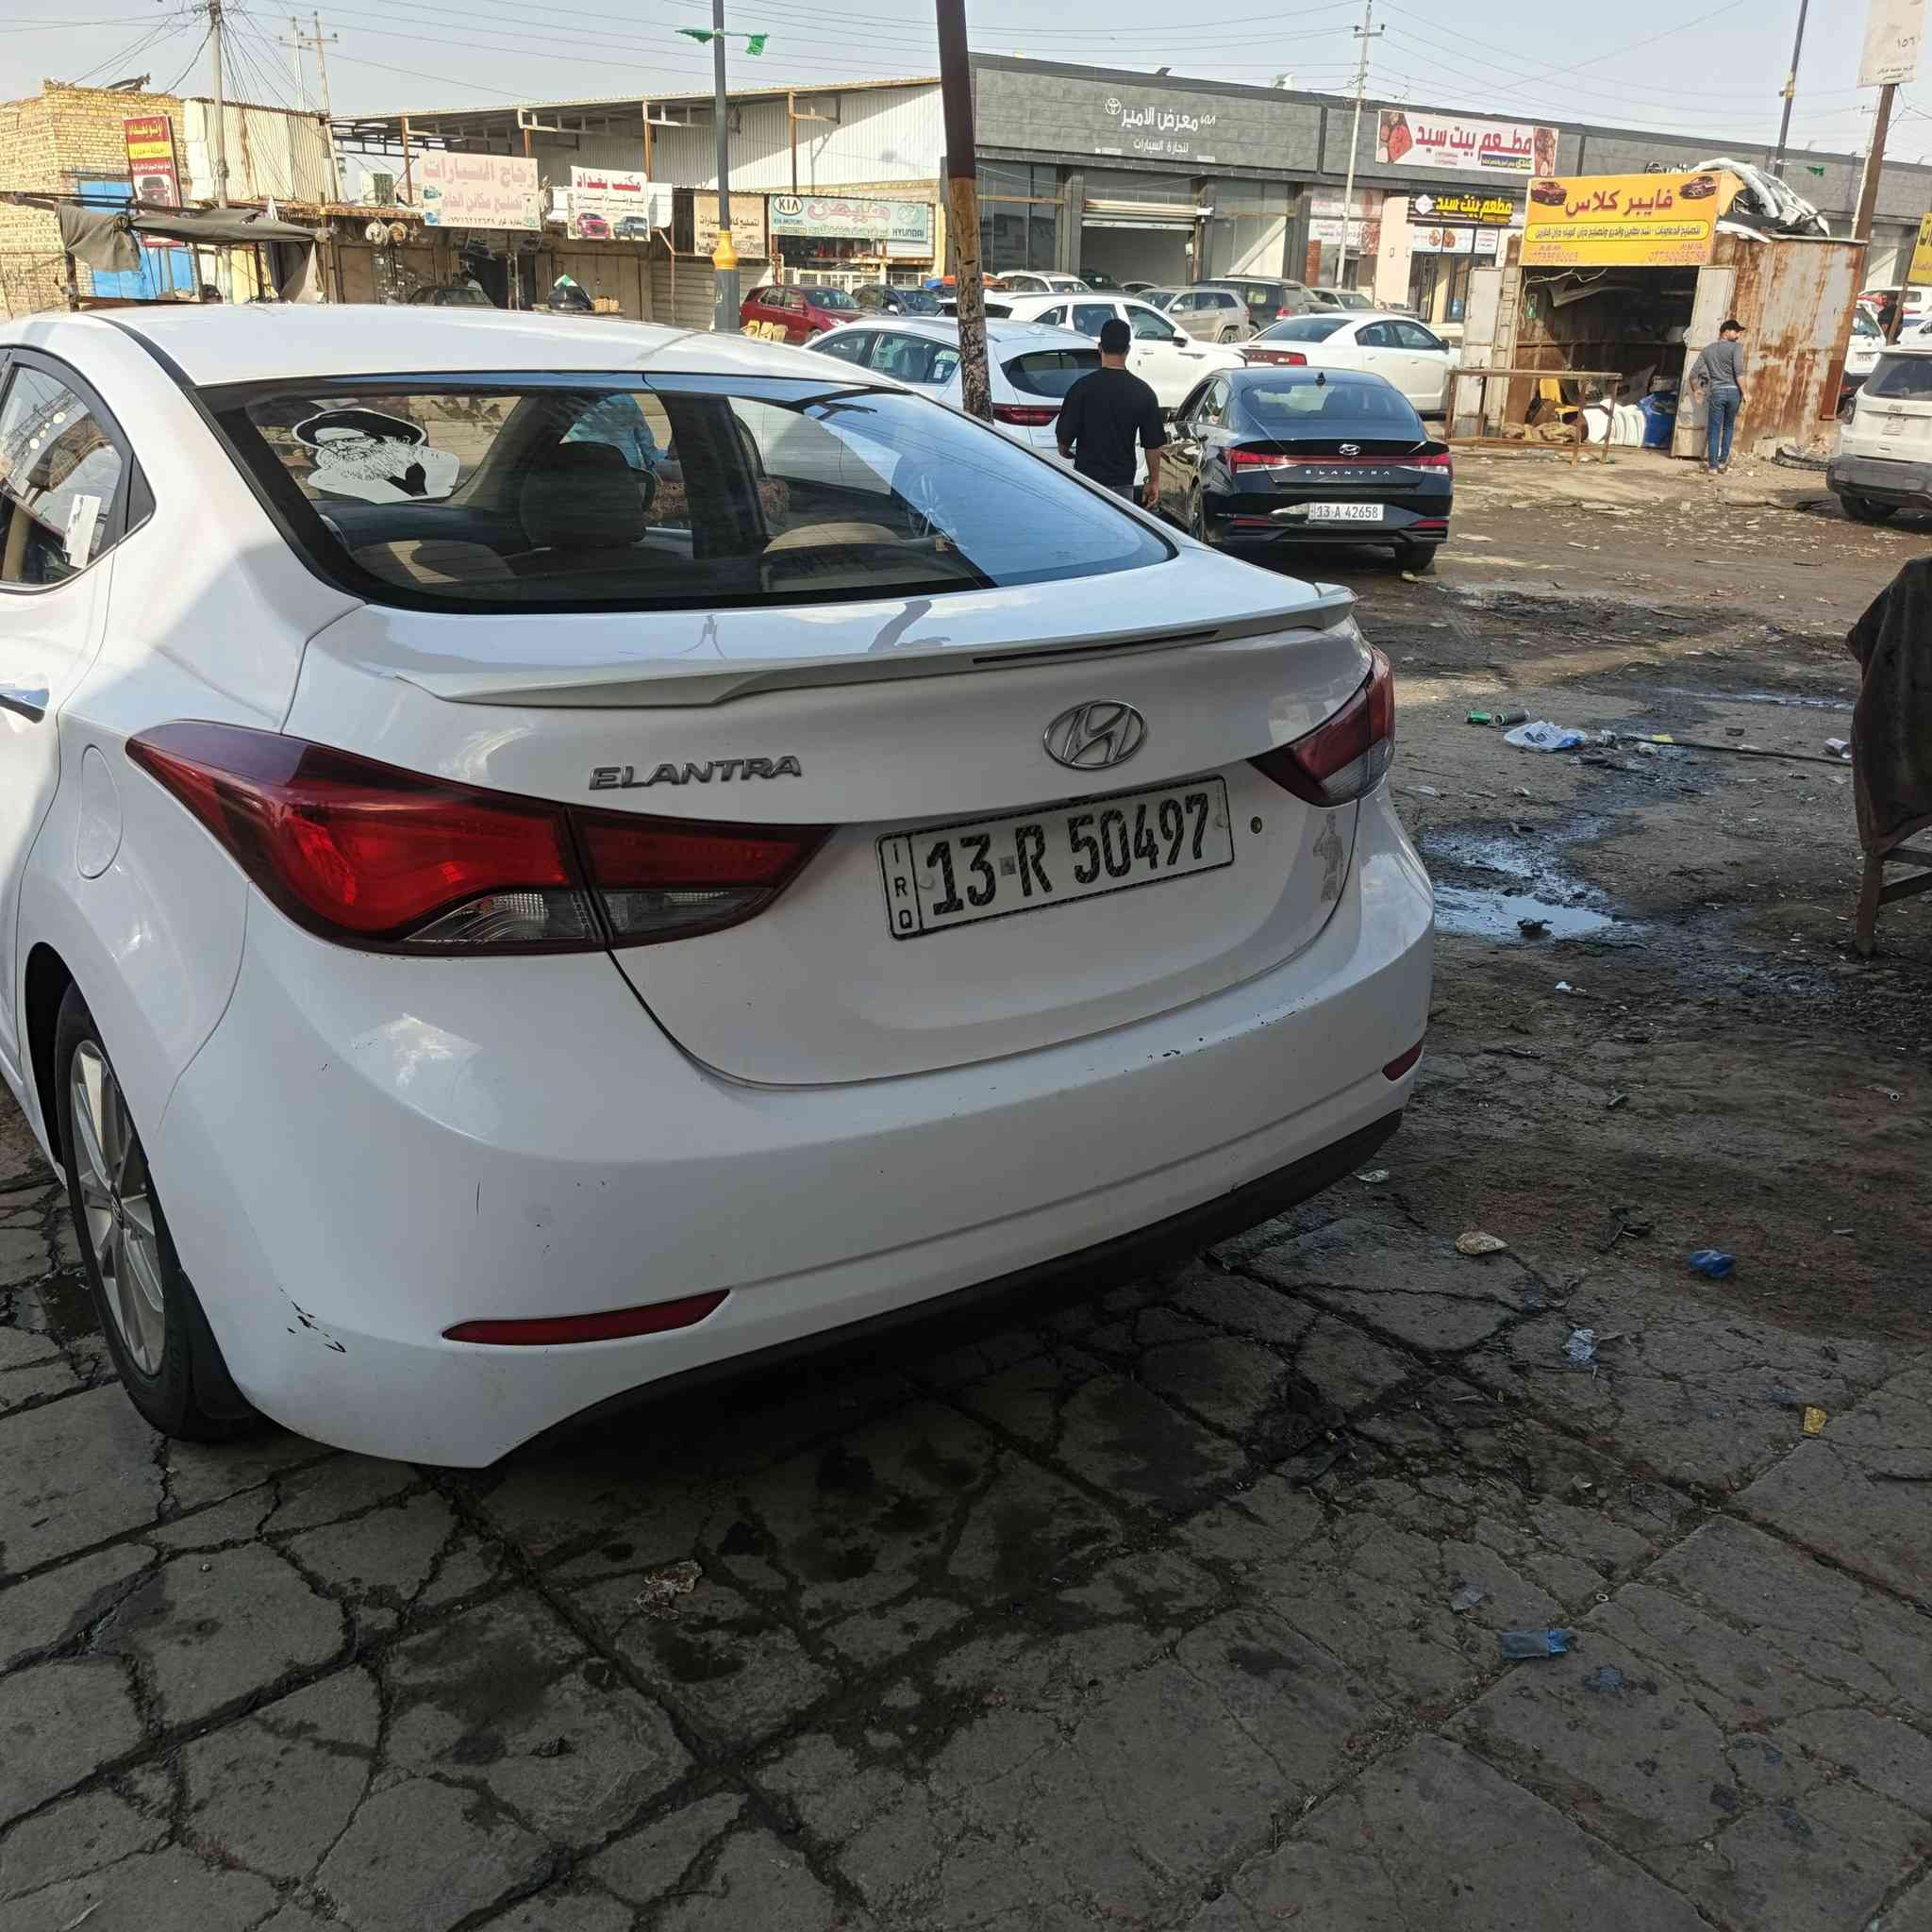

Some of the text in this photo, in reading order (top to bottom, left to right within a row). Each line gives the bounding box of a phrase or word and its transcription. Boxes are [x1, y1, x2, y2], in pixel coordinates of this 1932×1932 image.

[1121, 107, 1156, 128] الامير
[1158, 108, 1198, 132] معرض
[1133, 138, 1190, 155] لتجارة السيارات
[1416, 125, 1447, 153] سيد
[1449, 125, 1476, 158] بيت
[1477, 128, 1533, 160] مطعم
[423, 158, 536, 188] زجاج السيارات
[576, 173, 641, 192] مكتب بغداد
[779, 199, 799, 211] KIA
[1436, 196, 1459, 216] سيد
[1479, 195, 1513, 218] مطعم
[1565, 189, 1674, 217] فايبر كلاس
[892, 227, 924, 238] HYUNDAI
[1317, 506, 1331, 518] 13
[1335, 506, 1341, 518] A
[1344, 506, 1378, 519] 42658
[589, 755, 803, 791] ELANTRA
[926, 792, 1208, 915] 13 R 50497
